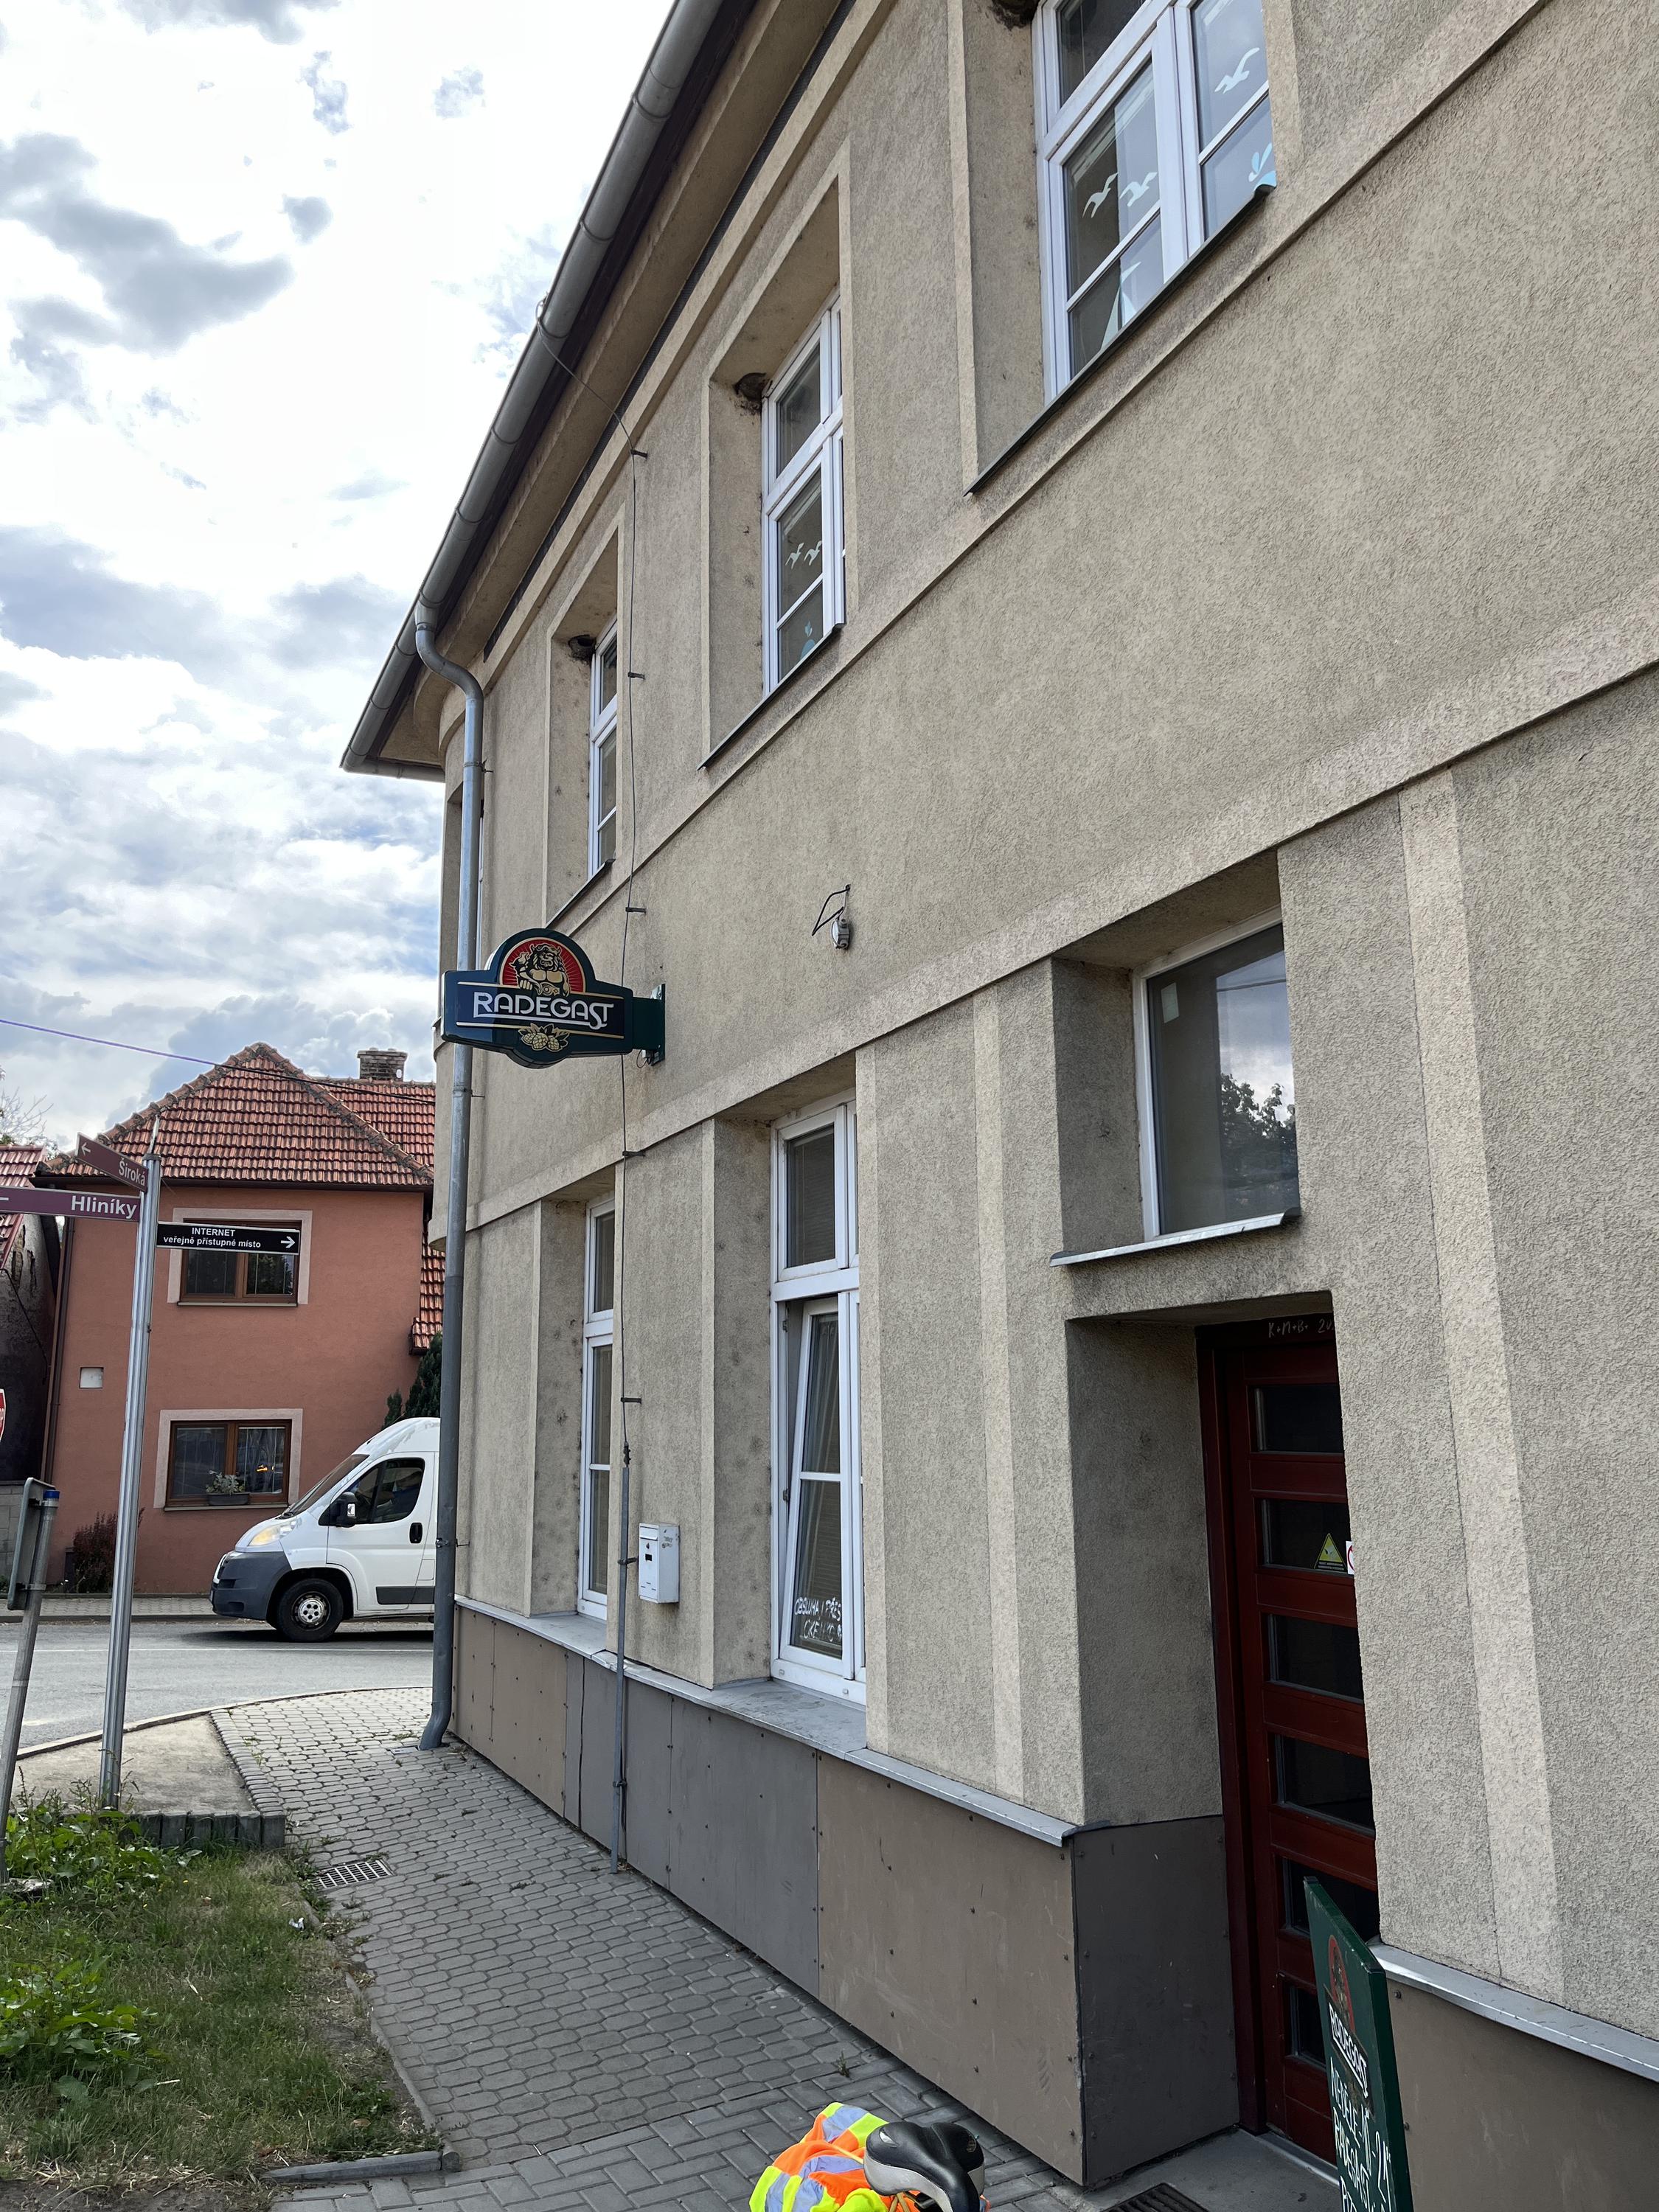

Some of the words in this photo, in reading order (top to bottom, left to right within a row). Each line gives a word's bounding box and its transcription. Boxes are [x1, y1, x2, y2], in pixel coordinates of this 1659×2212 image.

[473, 992, 614, 1030] RADEGAST
[118, 1156, 145, 1186] Široká
[71, 1194, 137, 1220] Hliníky
[163, 1235, 195, 1245] veřejně
[196, 1237, 236, 1248] přístupné
[238, 1239, 261, 1248] místo
[192, 1227, 235, 1237] INTERNET
[1328, 2002, 1368, 2099] RADEGAST
